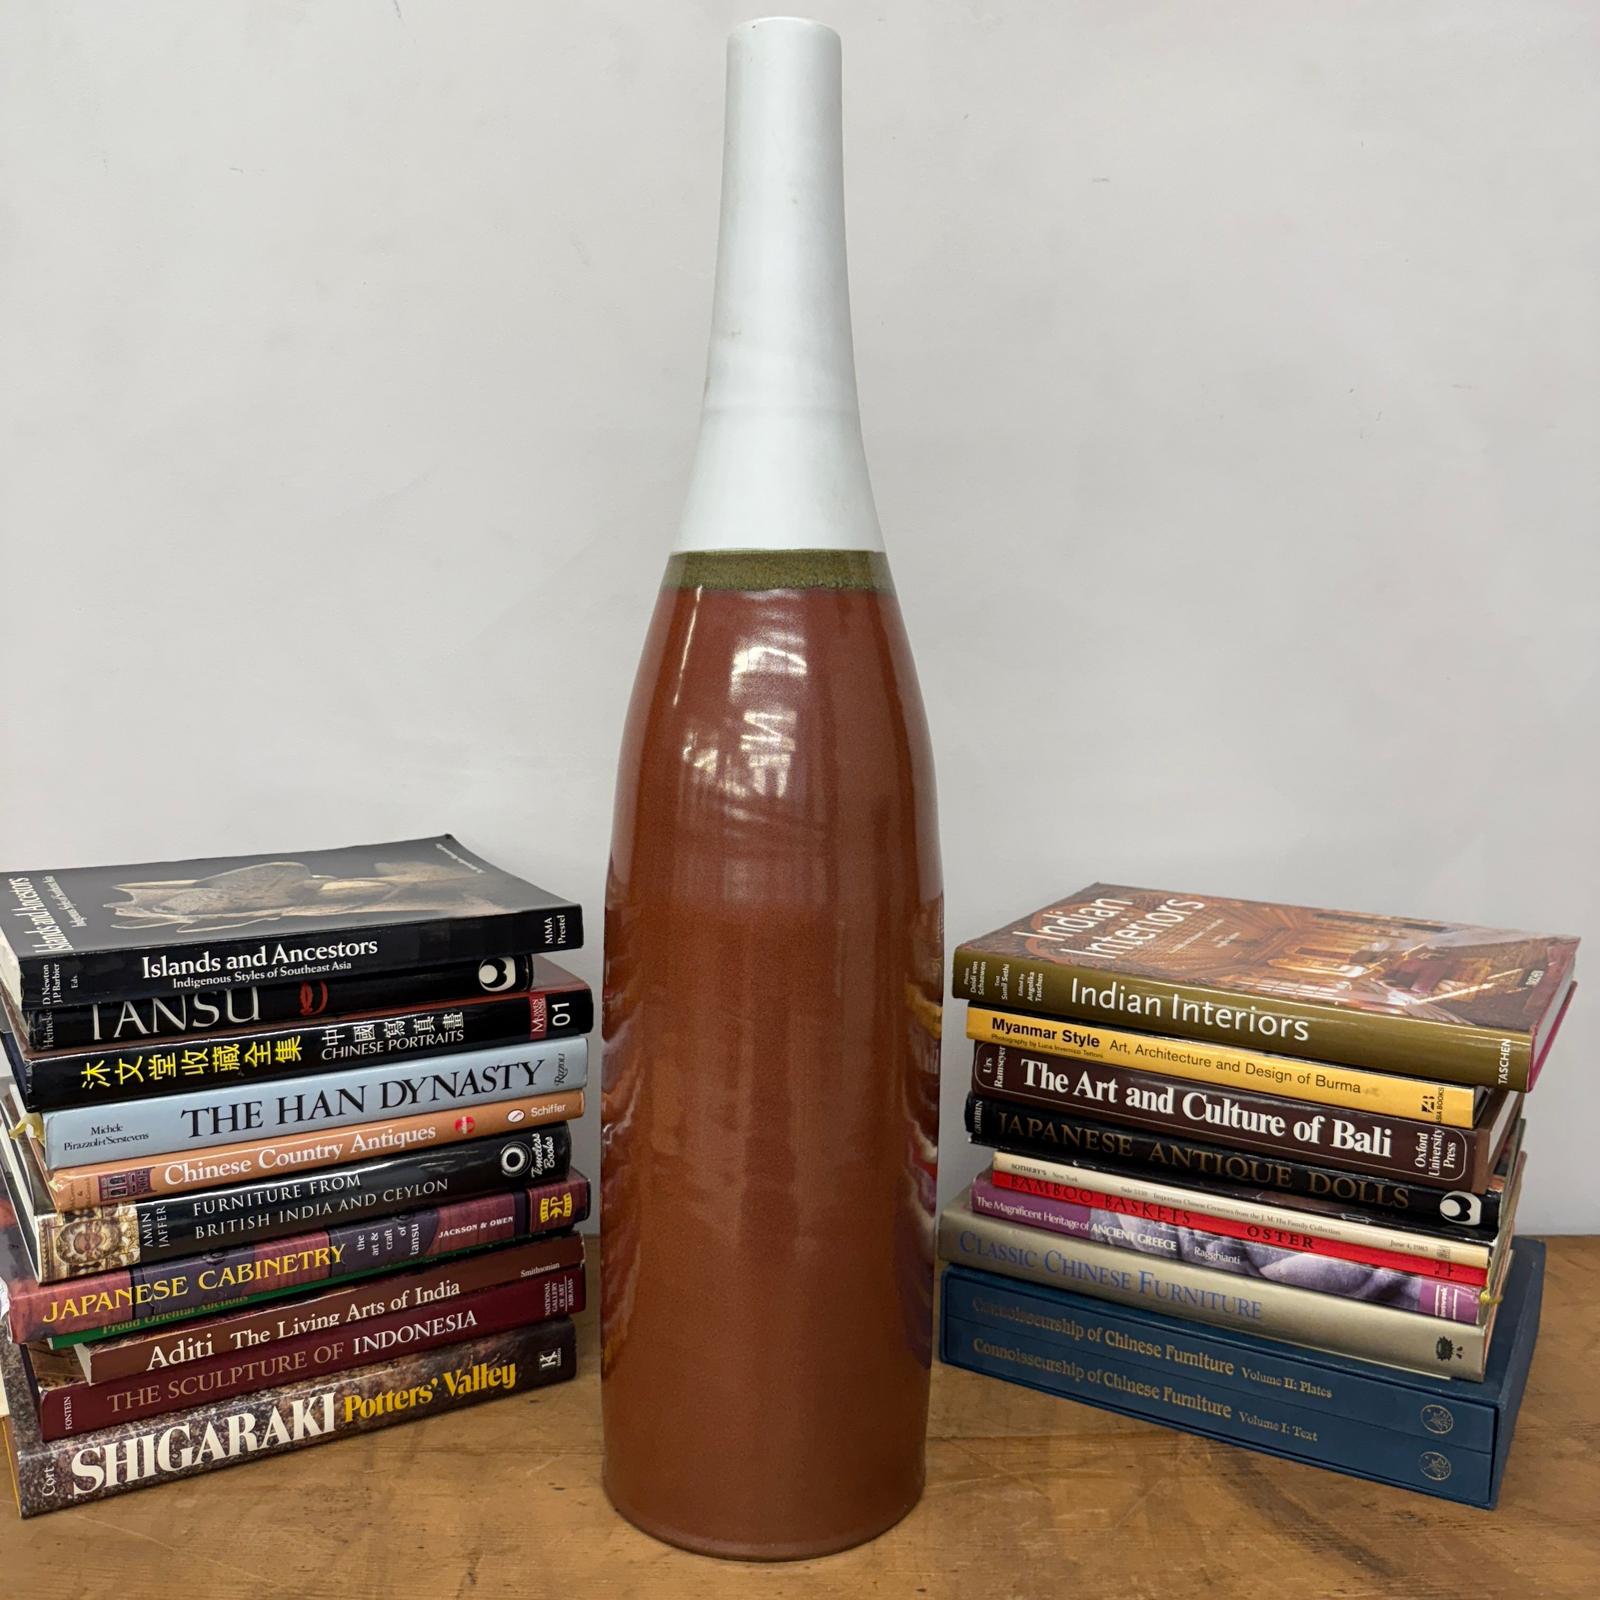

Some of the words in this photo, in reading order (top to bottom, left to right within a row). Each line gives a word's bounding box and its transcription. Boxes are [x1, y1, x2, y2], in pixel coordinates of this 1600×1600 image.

[545, 917, 553, 944] MMA
[557, 915, 566, 944] Prestel
[1012, 897, 1133, 942] Indian
[1060, 898, 1205, 959] Interiors
[142, 955, 221, 979] Islands
[227, 946, 267, 969] and
[272, 940, 378, 965] Ancestors
[173, 974, 231, 989] Indigenous
[235, 969, 265, 983] Styles
[267, 967, 280, 978] of
[281, 961, 330, 977] Southeast
[332, 960, 352, 971] Asia
[1002, 963, 1010, 981] Sethi
[1027, 971, 1035, 1001] Angelika
[1035, 973, 1044, 1001] Taschen
[553, 1002, 570, 1027] 01
[1071, 978, 1161, 1017] Indian
[1172, 993, 1309, 1041] Interiors
[321, 1042, 384, 1061] CHINESE
[387, 1029, 464, 1050] PORTRAITS
[983, 1058, 992, 1073] Urs
[992, 1017, 1058, 1039] Myanmar
[1062, 1029, 1100, 1048] Style
[1109, 1040, 1131, 1055] Art,
[1135, 1044, 1212, 1068] Architecture
[1216, 1060, 1240, 1073] and
[1245, 1064, 1292, 1083] Design
[1297, 1073, 1311, 1085] of
[1315, 1075, 1361, 1093] Burma
[1498, 1038, 1512, 1085] TASCHEN
[994, 1047, 1006, 1089] Ramseyer
[181, 1101, 264, 1139] THE
[276, 1084, 367, 1125] HAN
[379, 1059, 545, 1110] DYNASTY
[531, 1103, 566, 1117] Schiffer
[1021, 1059, 1069, 1093] The
[1074, 1070, 1119, 1103] Art
[1126, 1086, 1174, 1115] and
[1182, 1092, 1286, 1137] Culture
[1293, 1115, 1325, 1144] of
[1330, 1118, 1392, 1158] Bali
[164, 1159, 252, 1185] Chinese
[258, 1143, 343, 1169] Country
[351, 1126, 436, 1153] Antiques
[998, 1112, 1133, 1157] JAPANESE
[1150, 1141, 1293, 1187] ANTIQUE
[1308, 1171, 1409, 1209] DOLLS
[1414, 1132, 1428, 1168] Oxford
[1429, 1128, 1444, 1176] University
[1443, 1142, 1456, 1168] Press
[194, 1185, 301, 1216] FURNITURE
[310, 1174, 361, 1196] FROM
[195, 1213, 270, 1239] BRITISH
[280, 1202, 333, 1224] INDIA
[338, 1193, 377, 1212] AND
[383, 1178, 448, 1203] CEYLON
[1010, 1175, 1093, 1204] BAMBOO
[1104, 1195, 1191, 1225] BASKETS
[1247, 1224, 1314, 1249] OSTER
[142, 1212, 153, 1248] AMIN
[157, 1206, 170, 1248] JAFFER
[357, 1234, 365, 1250] the
[372, 1232, 379, 1242] &
[399, 1226, 406, 1237] of
[438, 1224, 478, 1239] JACKSON
[480, 1221, 487, 1229] &
[489, 1216, 514, 1227] OWEN
[977, 1196, 993, 1209] The
[994, 1202, 1042, 1221] Magnificent
[1044, 1212, 1080, 1230] Heritage
[1080, 1221, 1088, 1231] of
[1091, 1223, 1135, 1242] ANCIENT
[1137, 1233, 1176, 1251] GREECE
[1194, 1247, 1240, 1265] Ragghianti
[43, 1276, 188, 1323] JAPANESE
[199, 1244, 345, 1290] CABINETRY
[520, 1262, 560, 1278] Smithsonian
[146, 1333, 215, 1371] Aditi
[230, 1329, 271, 1349] The
[277, 1313, 340, 1339] Living
[346, 1302, 385, 1322] Arts
[390, 1289, 410, 1309] of
[415, 1280, 460, 1304] India
[107, 1384, 161, 1413] THE
[168, 1350, 308, 1400] SCULPTURE
[314, 1341, 344, 1364] OF
[353, 1309, 478, 1356] INDONESIA
[1087, 1328, 1103, 1342] of
[1104, 1330, 1161, 1358] Chinese
[1165, 1344, 1235, 1376] Furniture
[1241, 1367, 1281, 1387] Volume
[1300, 1382, 1332, 1399] Plates
[973, 1338, 1084, 1382] Connoisseurship
[1087, 1369, 1103, 1383] of
[1103, 1371, 1159, 1399] Chinese
[1163, 1386, 1232, 1418] Furniture
[1239, 1411, 1279, 1432] Volume
[1292, 1425, 1318, 1442] Text
[64, 1396, 72, 1430] FONTEIN
[71, 1391, 336, 1496] SHIGARAKI
[443, 1362, 517, 1398] Valley
[42, 1467, 56, 1496] Cort
